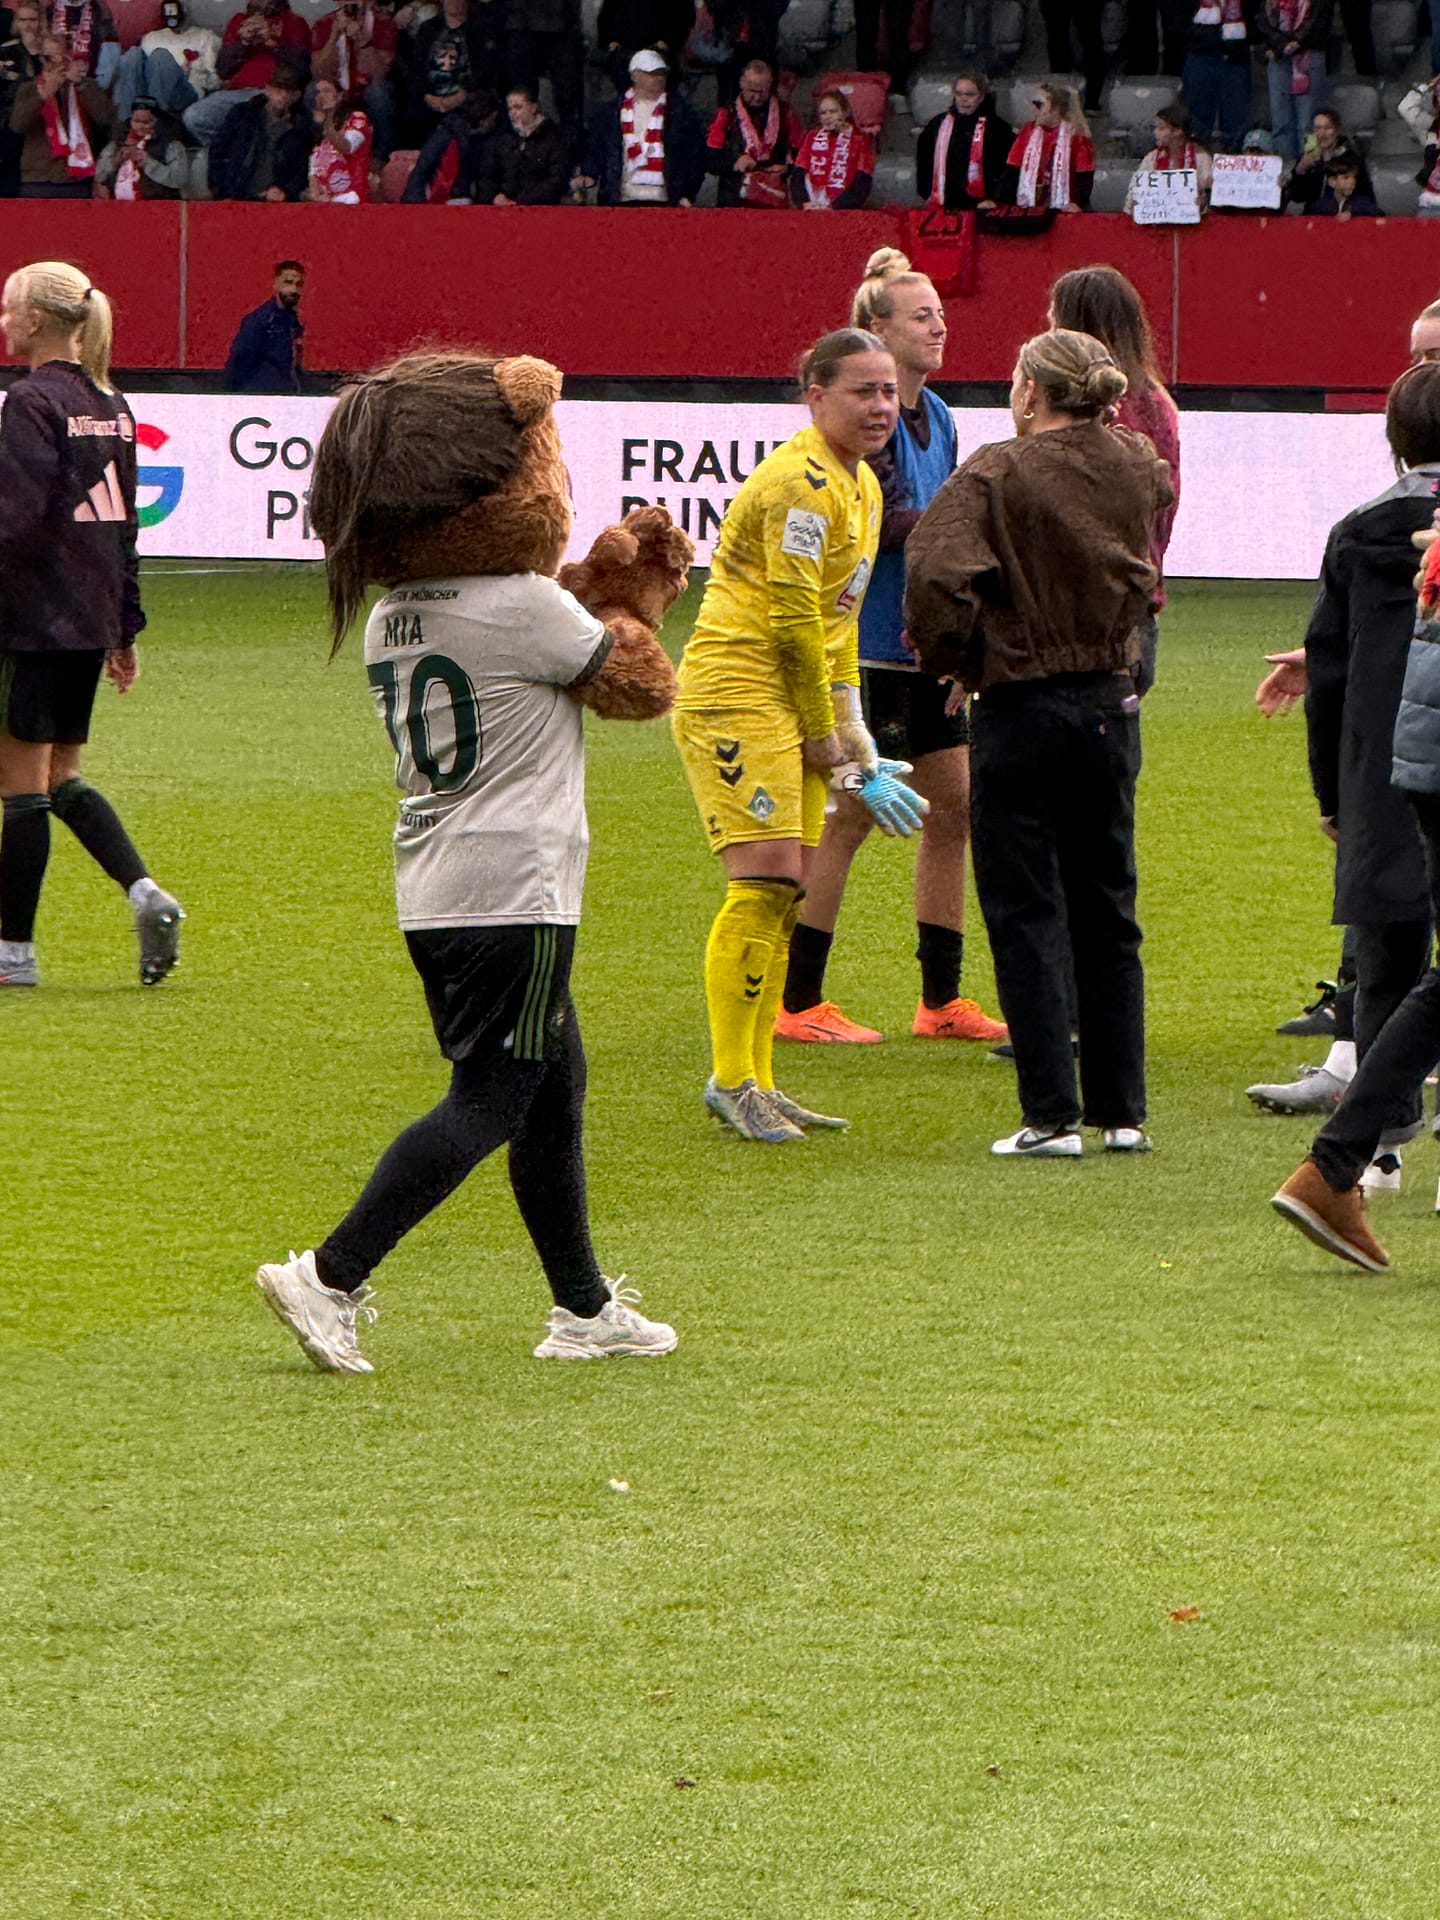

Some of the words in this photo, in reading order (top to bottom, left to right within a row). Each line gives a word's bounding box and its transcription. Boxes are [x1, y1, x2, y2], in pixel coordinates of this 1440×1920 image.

[622, 438, 787, 484] FRAU
[384, 614, 425, 648] MIA
[366, 654, 483, 796] 10
